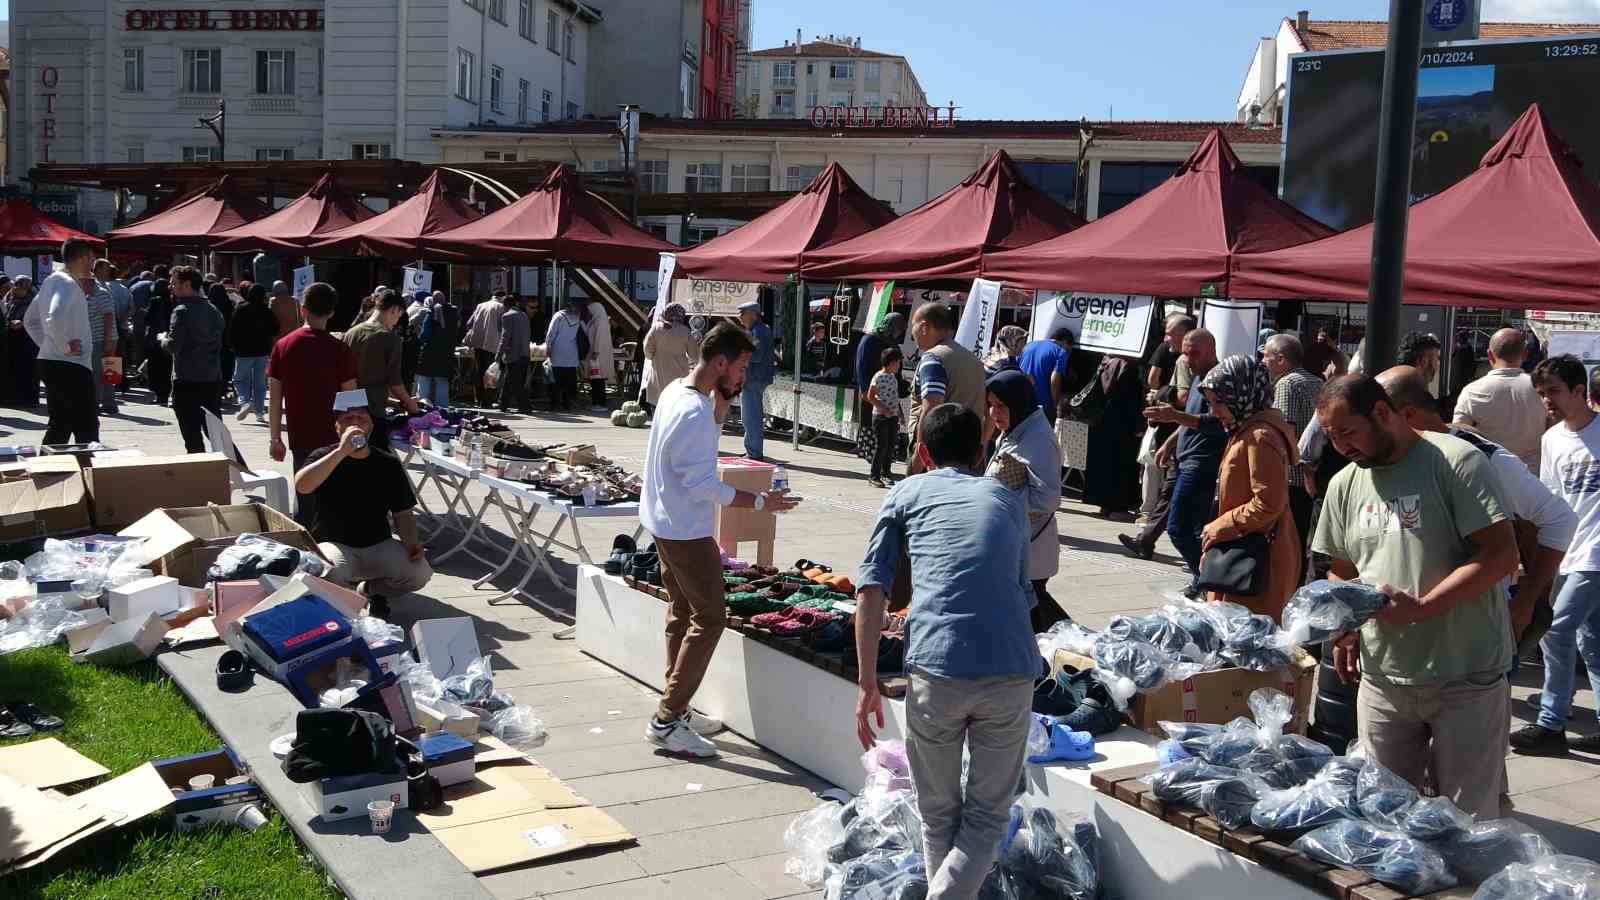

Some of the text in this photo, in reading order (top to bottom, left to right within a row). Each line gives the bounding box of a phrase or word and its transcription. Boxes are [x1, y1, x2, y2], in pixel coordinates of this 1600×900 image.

[126, 9, 217, 31] OTEL
[1419, 51, 1474, 65] /10/2024
[1545, 44, 1598, 58] 13:29:52
[811, 105, 875, 128] OTEL
